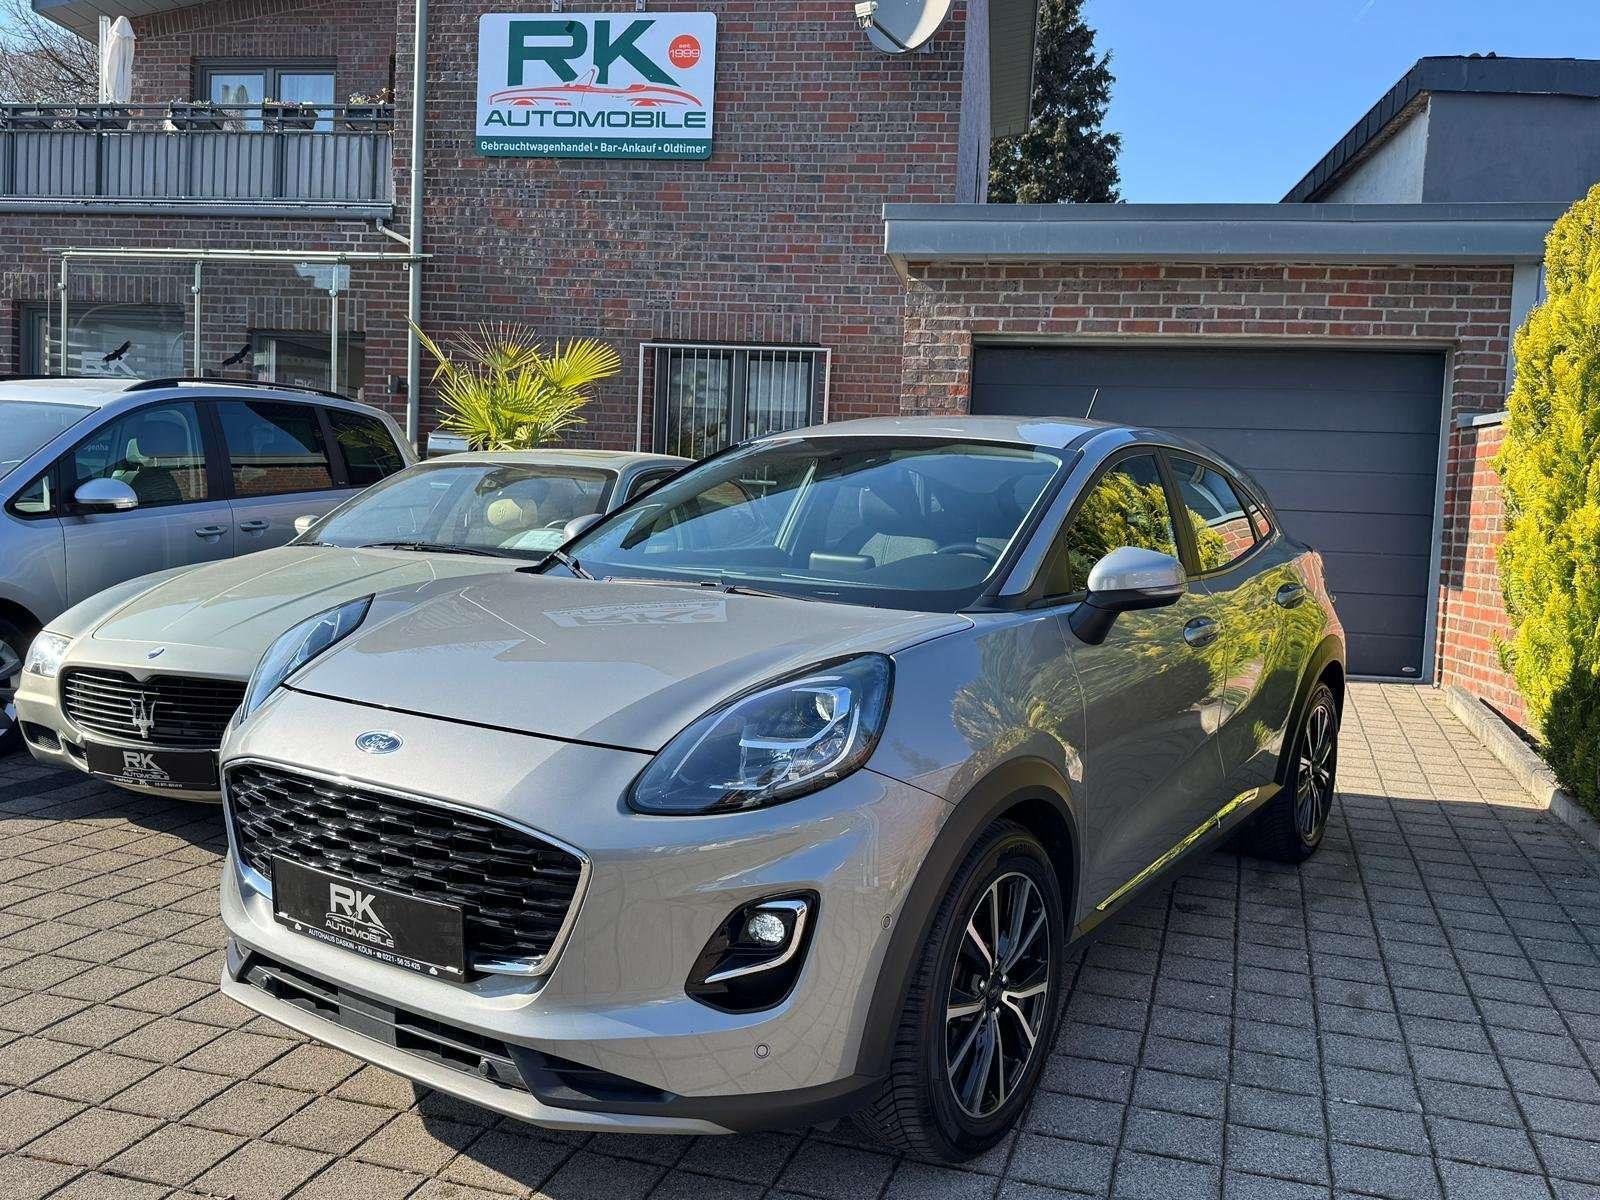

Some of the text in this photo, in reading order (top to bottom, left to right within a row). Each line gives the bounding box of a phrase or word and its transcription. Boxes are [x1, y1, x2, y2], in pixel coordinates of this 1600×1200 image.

[507, 19, 681, 87] RK
[670, 49, 700, 58] 1999
[484, 110, 706, 129] AUTOMOBILE
[480, 141, 706, 154] Gebrauchtwagenhandel Bar-Ankauf Oldtimer
[122, 751, 163, 771] RK
[329, 882, 385, 928] RK
[308, 928, 336, 943] AUTOHAUS
[357, 944, 373, 956] KÖLN
[325, 918, 395, 949] AUTOMOBILE
